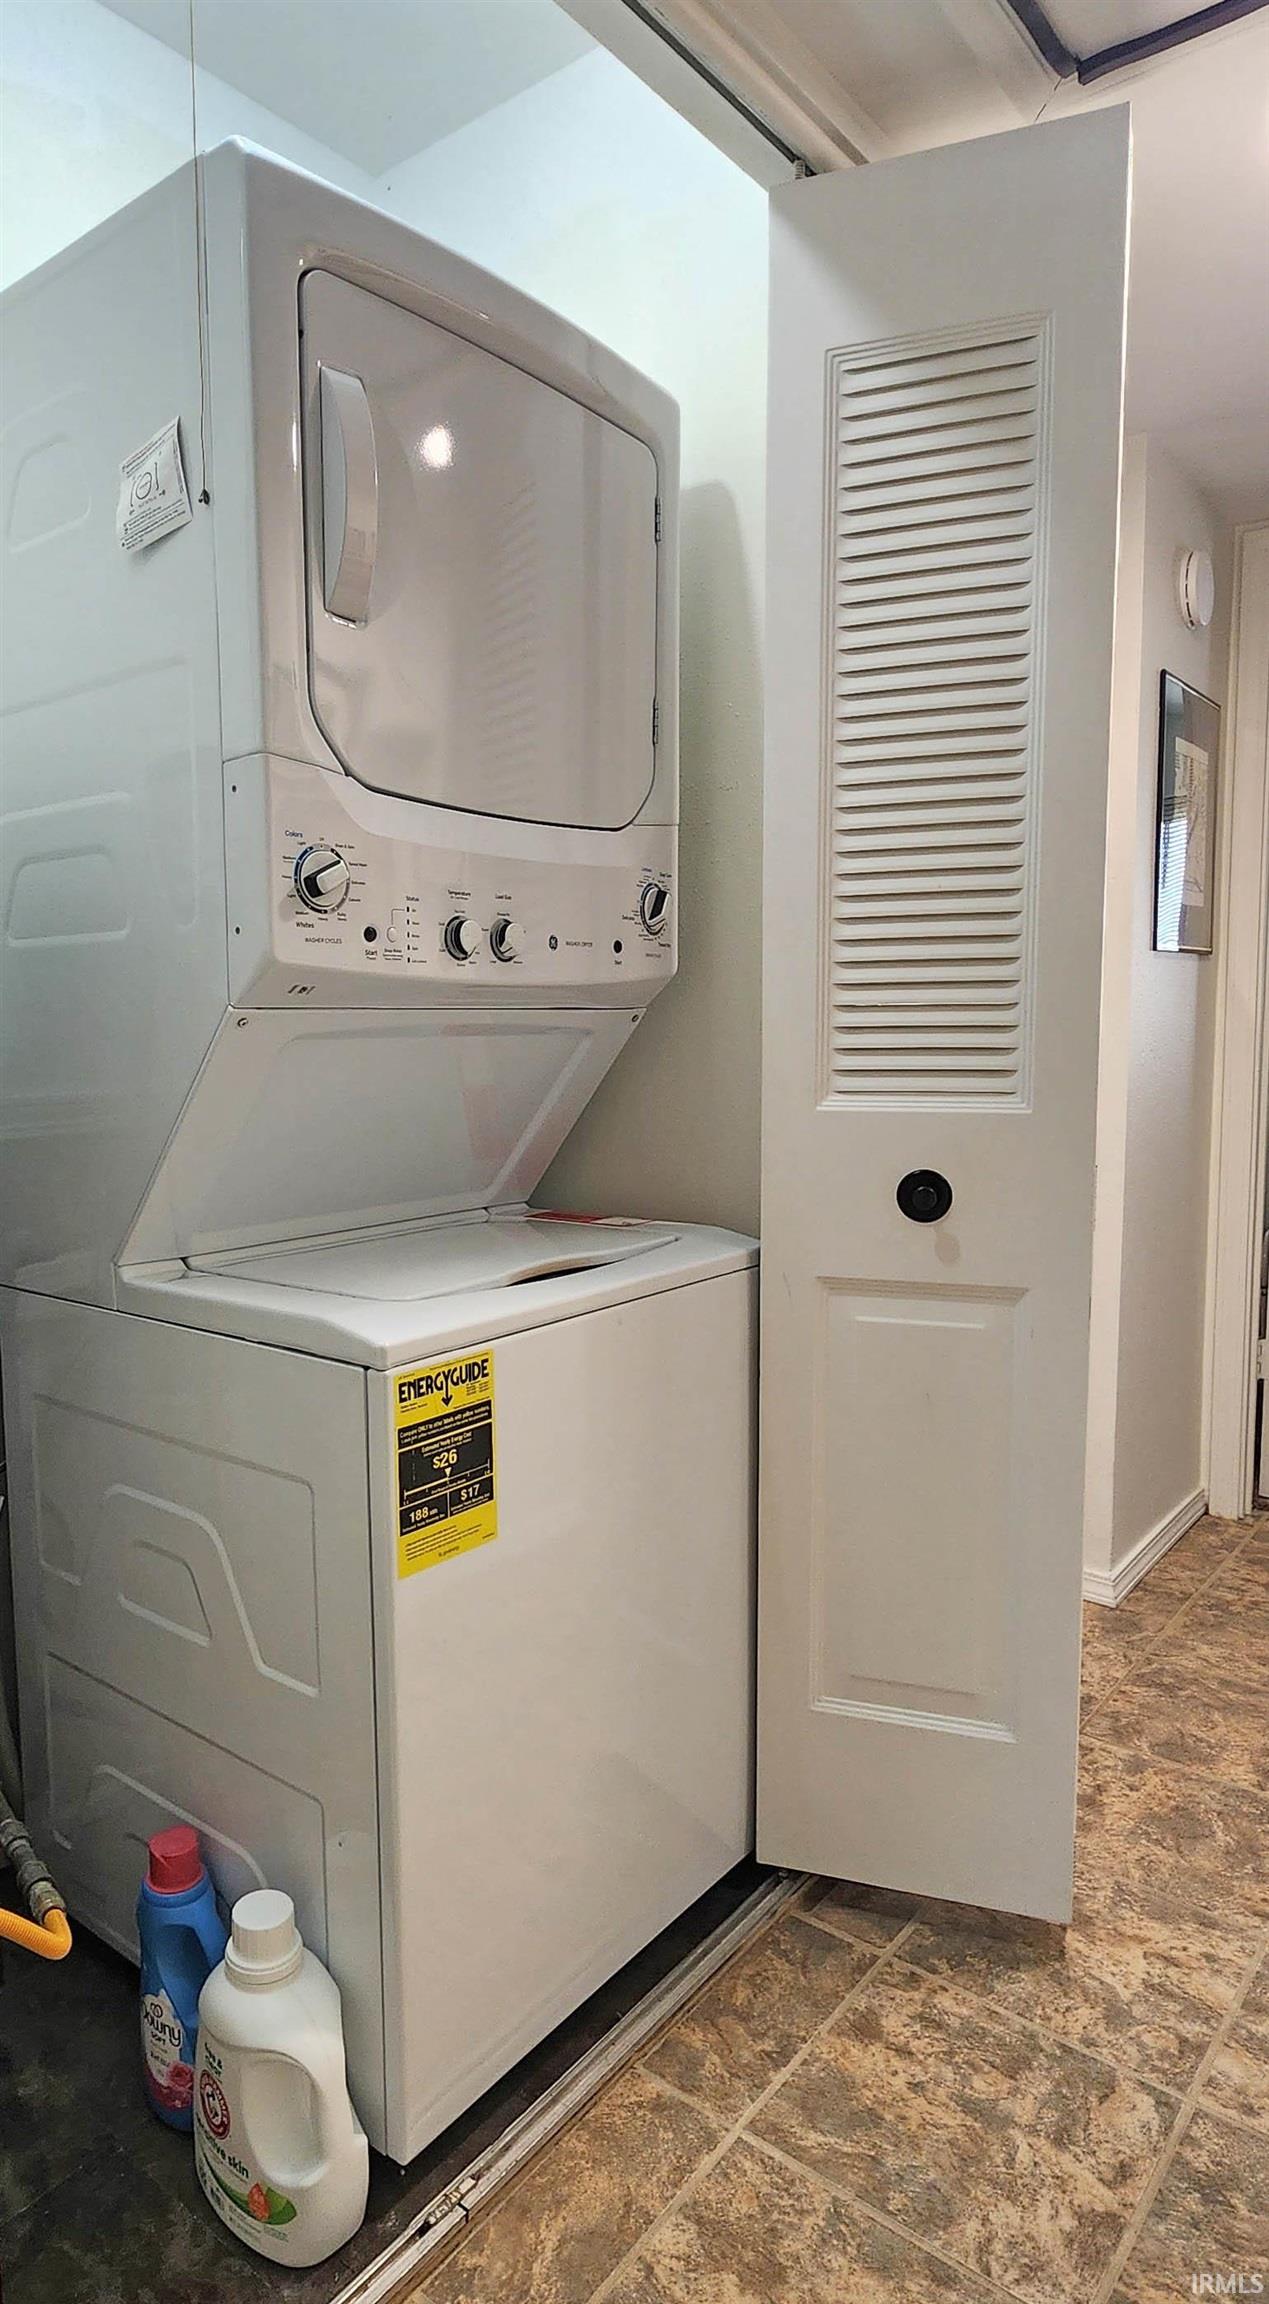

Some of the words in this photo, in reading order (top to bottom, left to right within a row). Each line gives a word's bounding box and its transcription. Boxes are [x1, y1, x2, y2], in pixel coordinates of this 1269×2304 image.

[284, 830, 303, 839] Colors
[296, 921, 315, 929] Whites
[398, 1358, 490, 1405] ENERGYGUIDE
[432, 1448, 458, 1470] $26
[460, 1484, 480, 1501] $17
[409, 1506, 429, 1523] 188
[228, 2154, 250, 2180] skin
